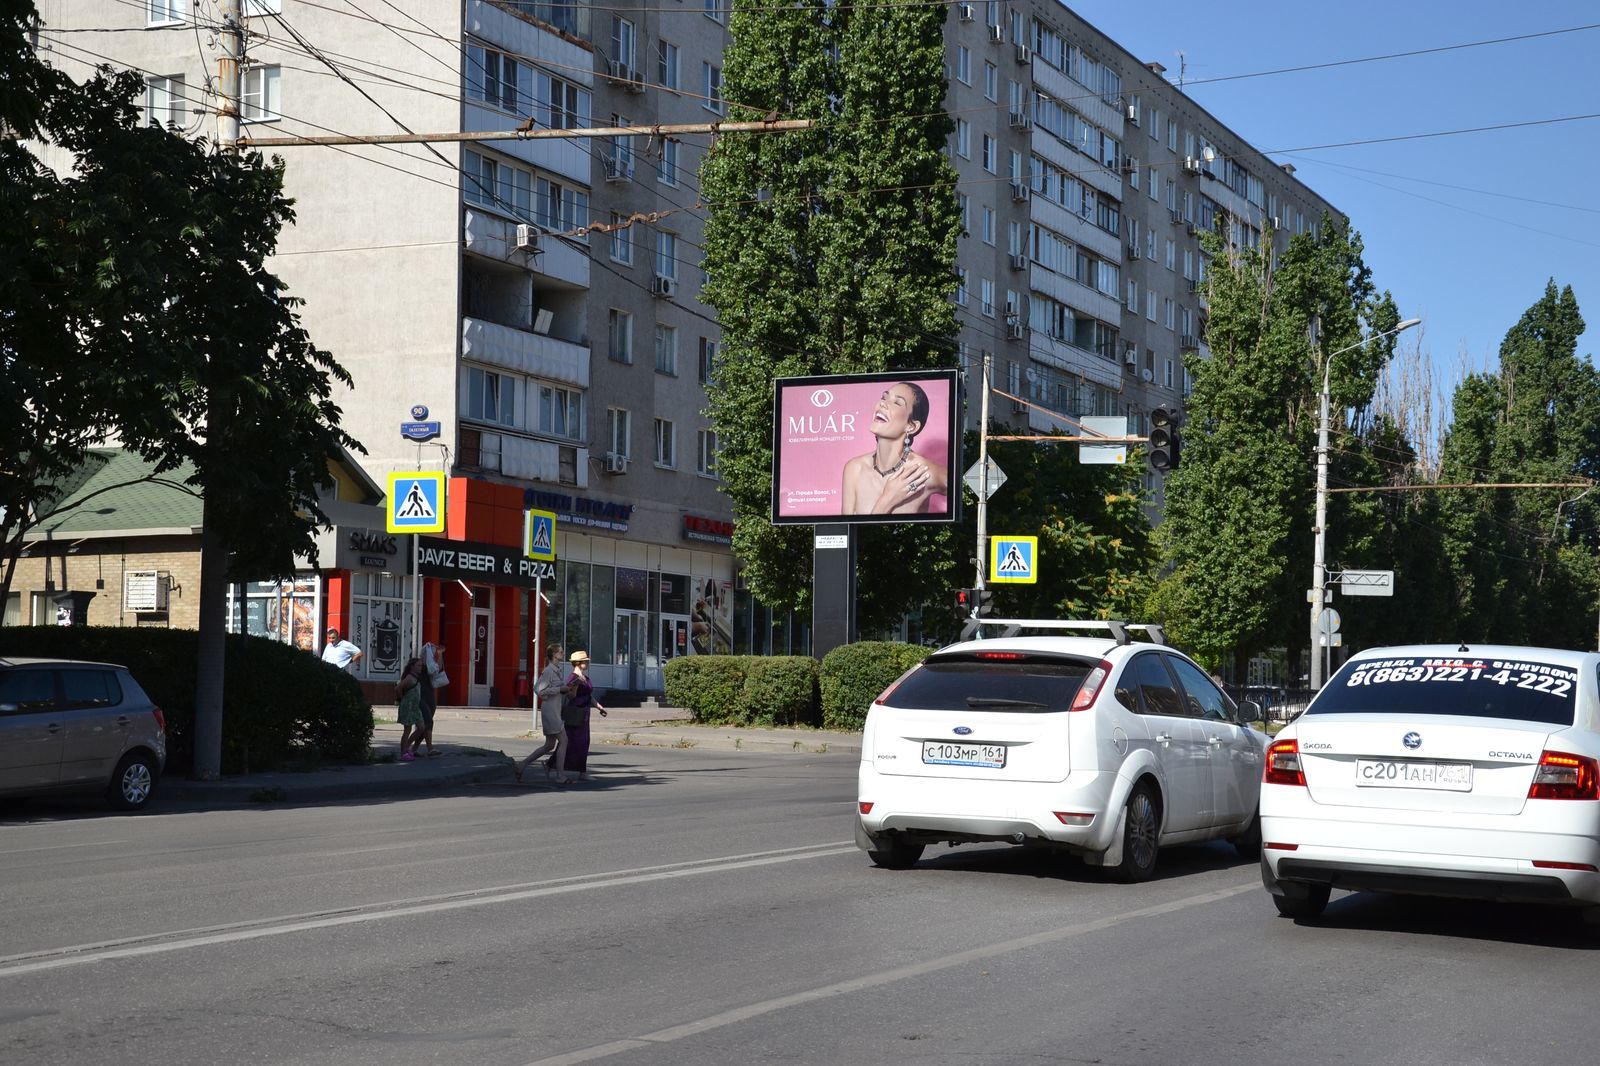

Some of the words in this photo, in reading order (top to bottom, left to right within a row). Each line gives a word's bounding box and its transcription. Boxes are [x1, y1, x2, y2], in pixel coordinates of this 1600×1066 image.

[349, 532, 398, 555] SMAKS
[458, 552, 495, 572] BEER
[503, 557, 512, 574] &
[519, 560, 556, 580] PIZZA
[1355, 659, 1415, 672] АРЕНДА
[1422, 659, 1463, 667] АВТО
[1492, 661, 1578, 682] ВЫКУПОМ
[1347, 667, 1572, 698] 8(863)221-4-222
[1488, 751, 1534, 760] OCTAVIA
